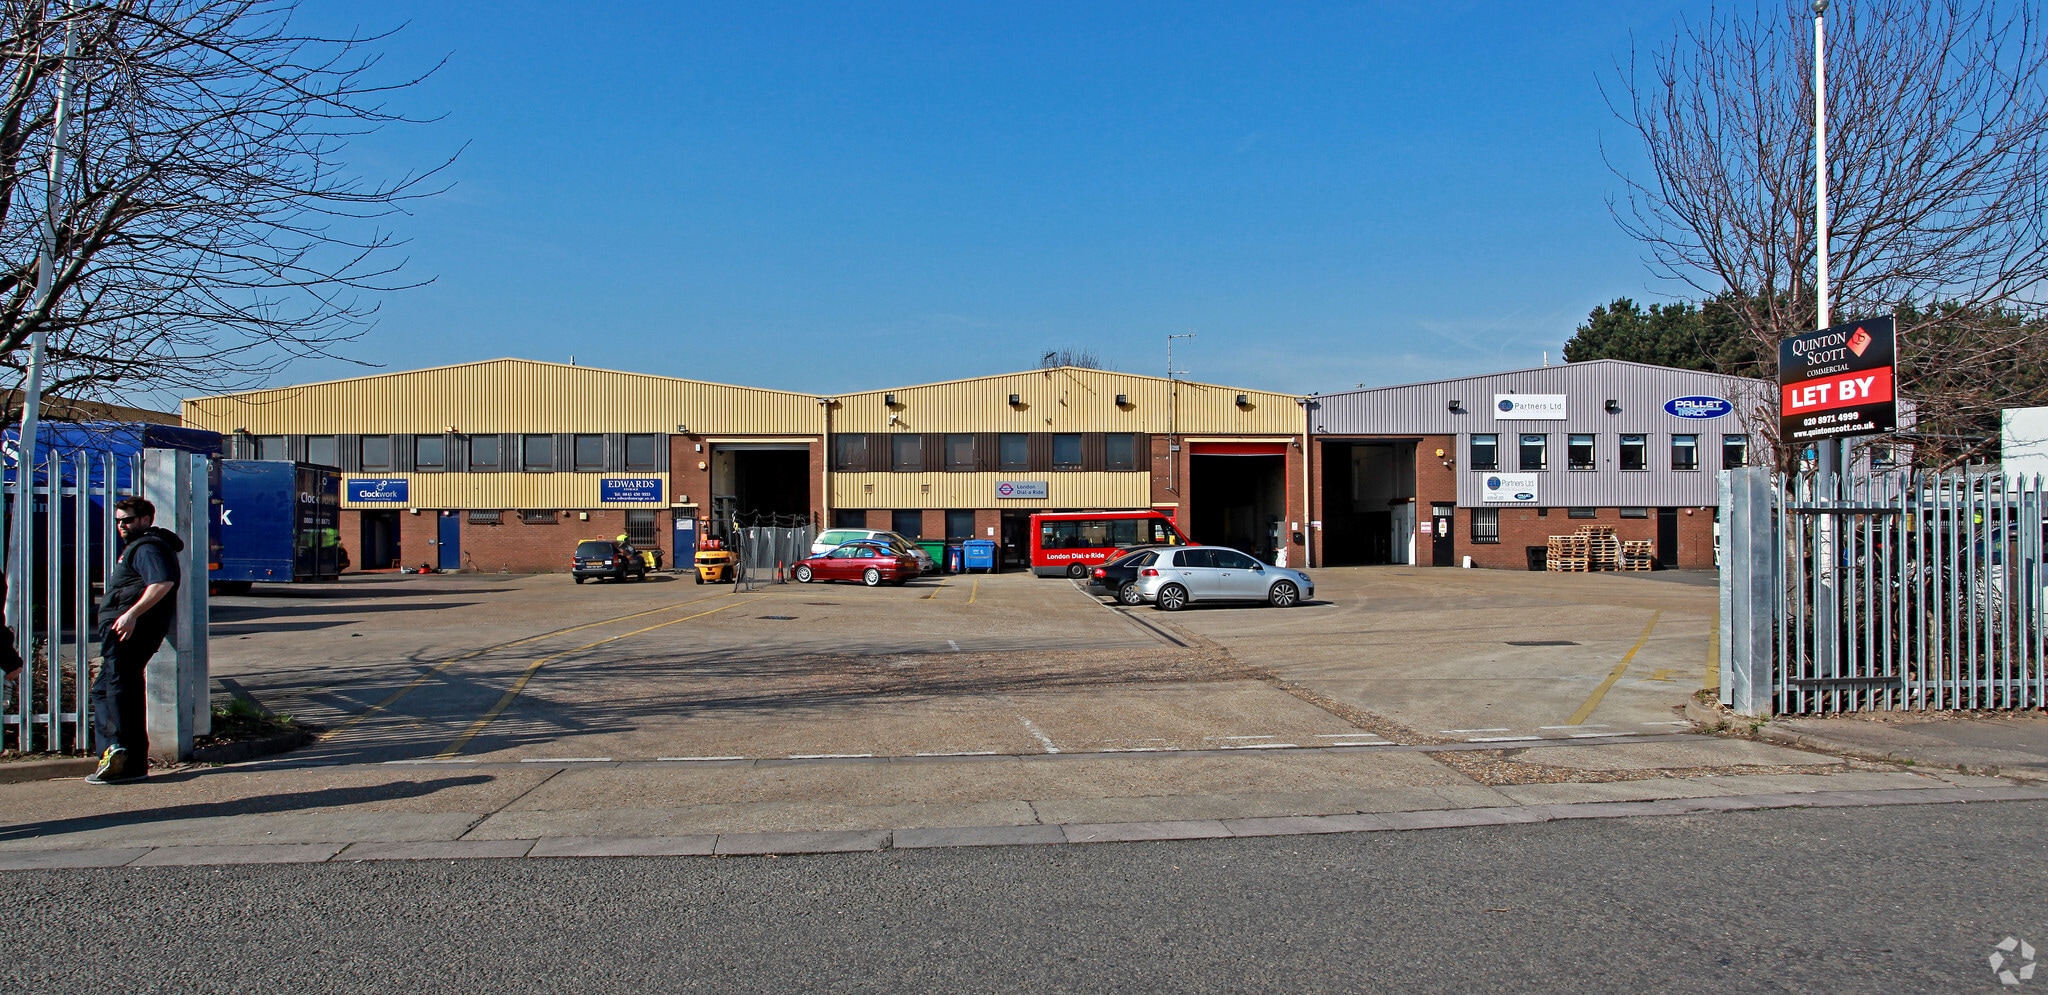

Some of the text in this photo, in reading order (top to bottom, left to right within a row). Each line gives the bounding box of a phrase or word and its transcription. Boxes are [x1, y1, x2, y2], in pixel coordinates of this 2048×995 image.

[1793, 332, 1846, 356] QUINTON
[1807, 347, 1847, 366] SCOTT
[1807, 363, 1849, 378] COMMERCIAL
[1792, 376, 1875, 408] LET BY
[1515, 402, 1546, 410] Partners
[1675, 400, 1723, 408] PALLET
[1677, 408, 1708, 417] TRACK
[1804, 412, 1859, 426] 020 8971 4999
[1793, 421, 1875, 438] www.quintonscott.co.uk
[608, 480, 655, 488] EDWARDS
[1502, 479, 1525, 487] Partners
[360, 490, 397, 498] Clockwork
